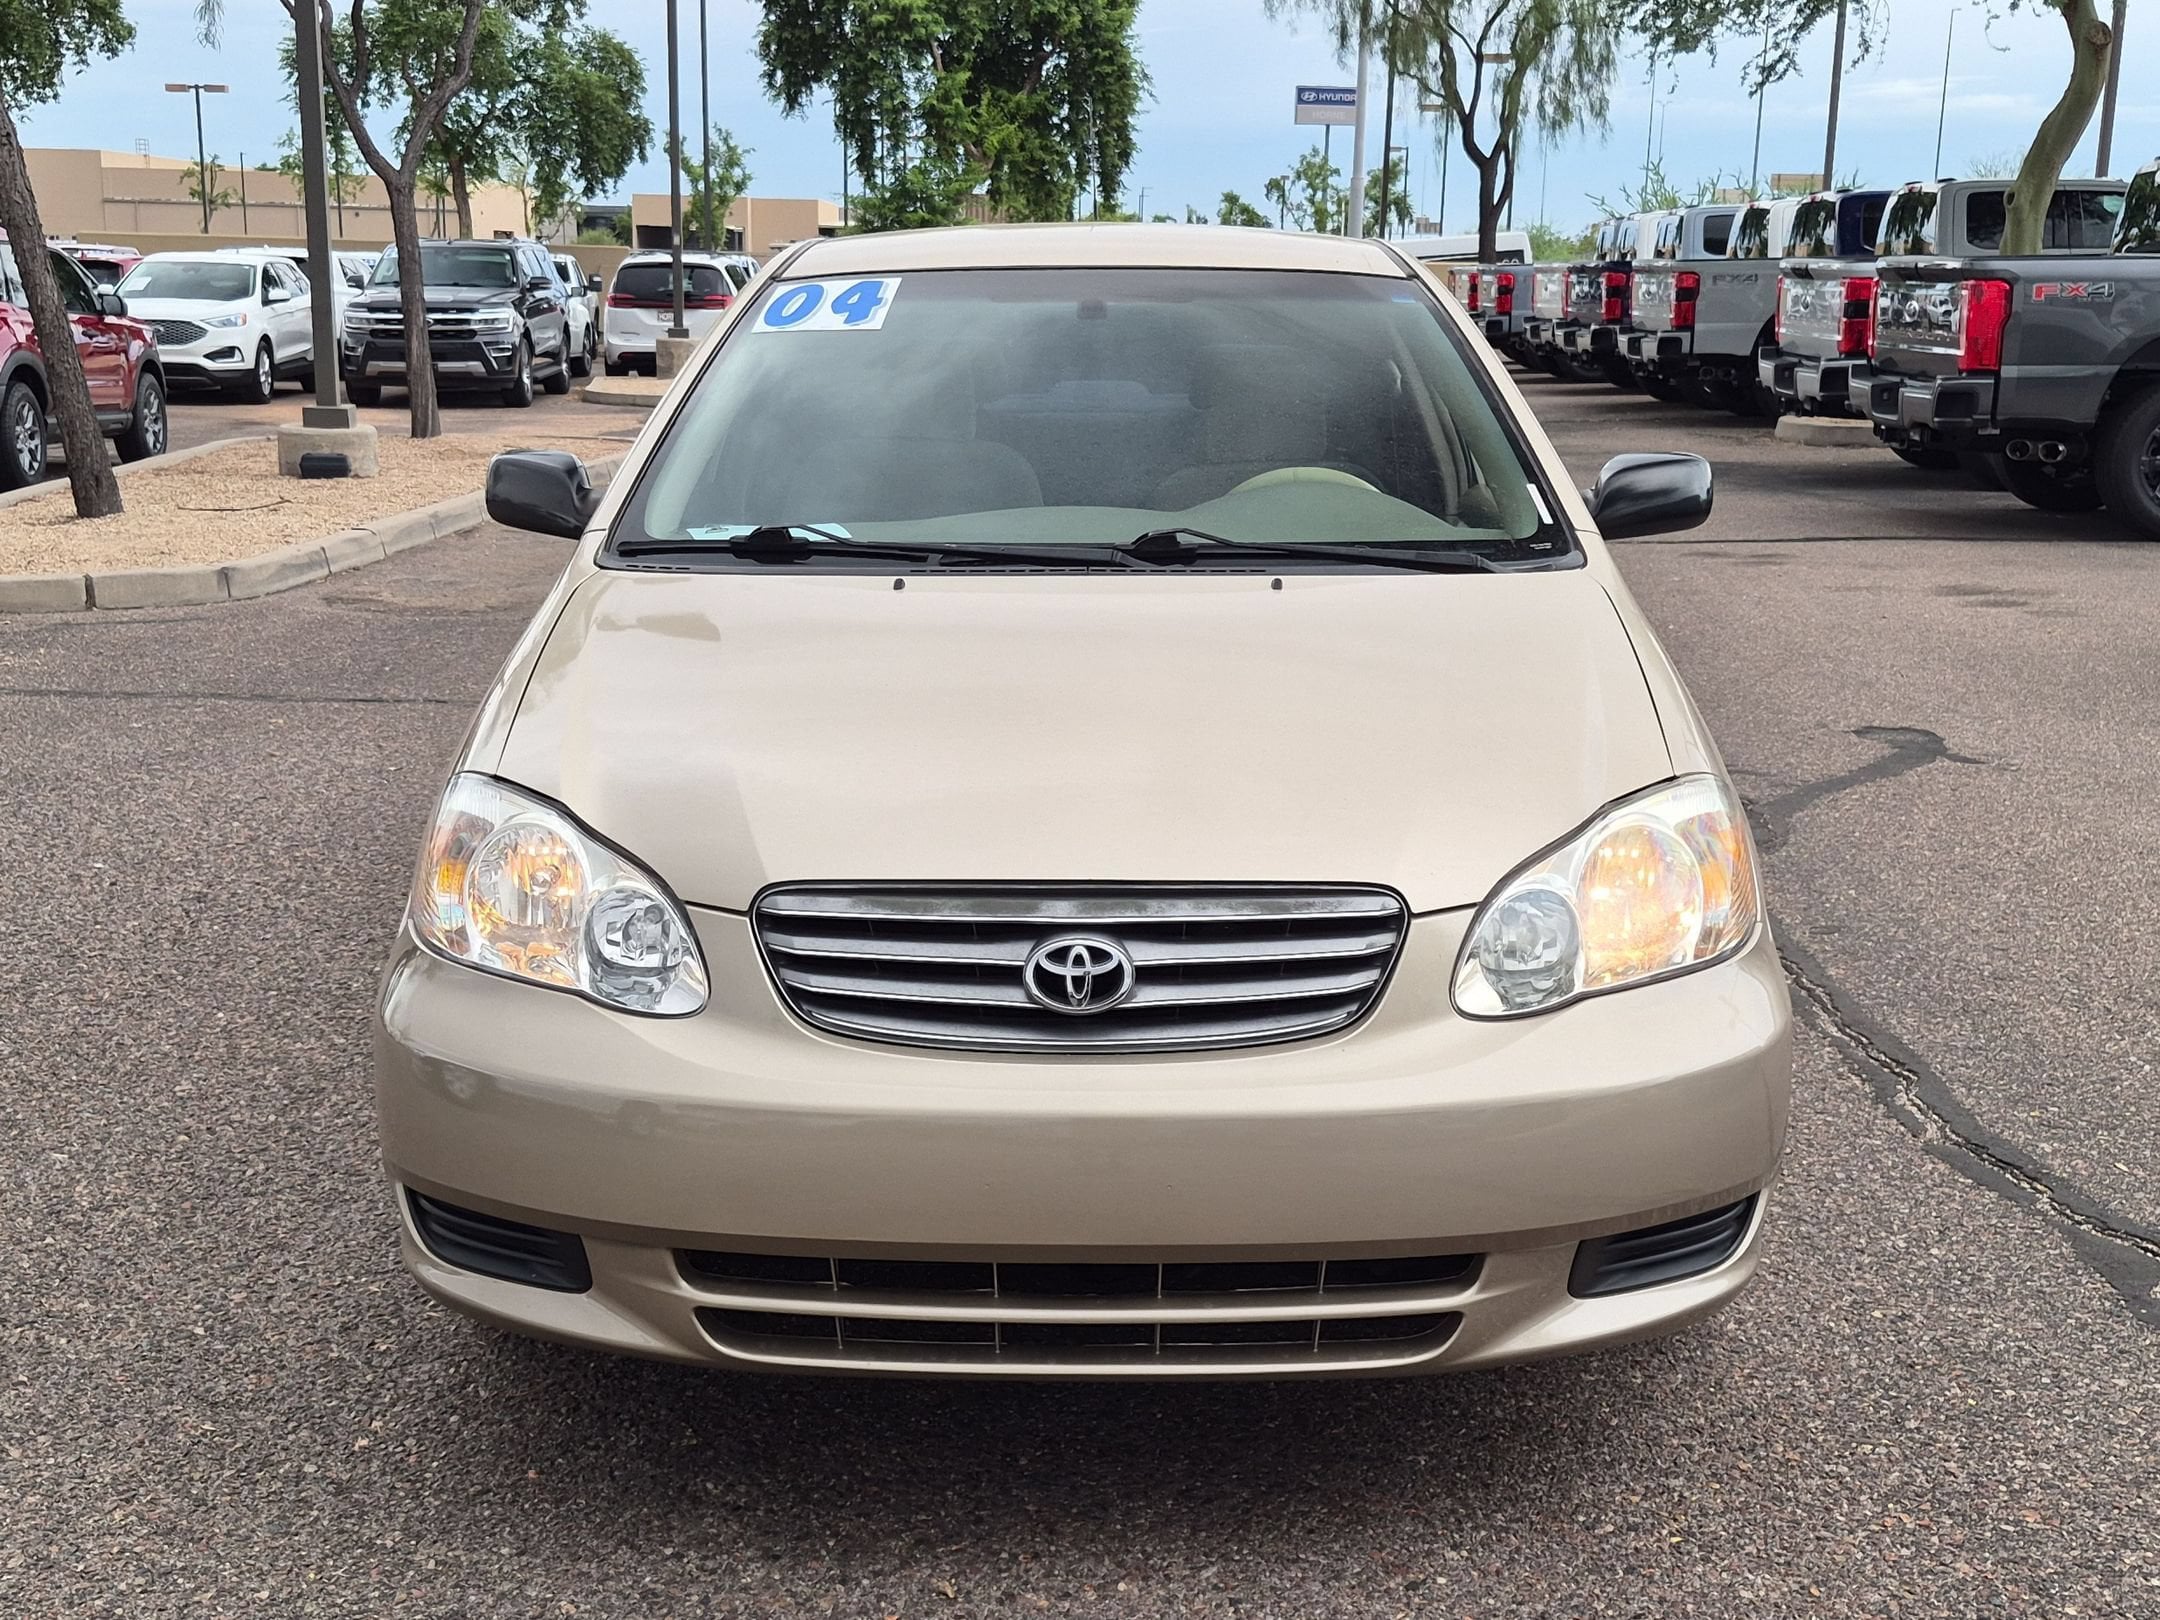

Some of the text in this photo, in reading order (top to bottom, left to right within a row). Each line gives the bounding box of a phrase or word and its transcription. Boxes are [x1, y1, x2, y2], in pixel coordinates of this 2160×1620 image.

[1319, 93, 1357, 102] HYUNDA
[1712, 273, 1758, 286] FX4
[2032, 281, 2115, 303] FX4
[763, 280, 888, 327] 04
